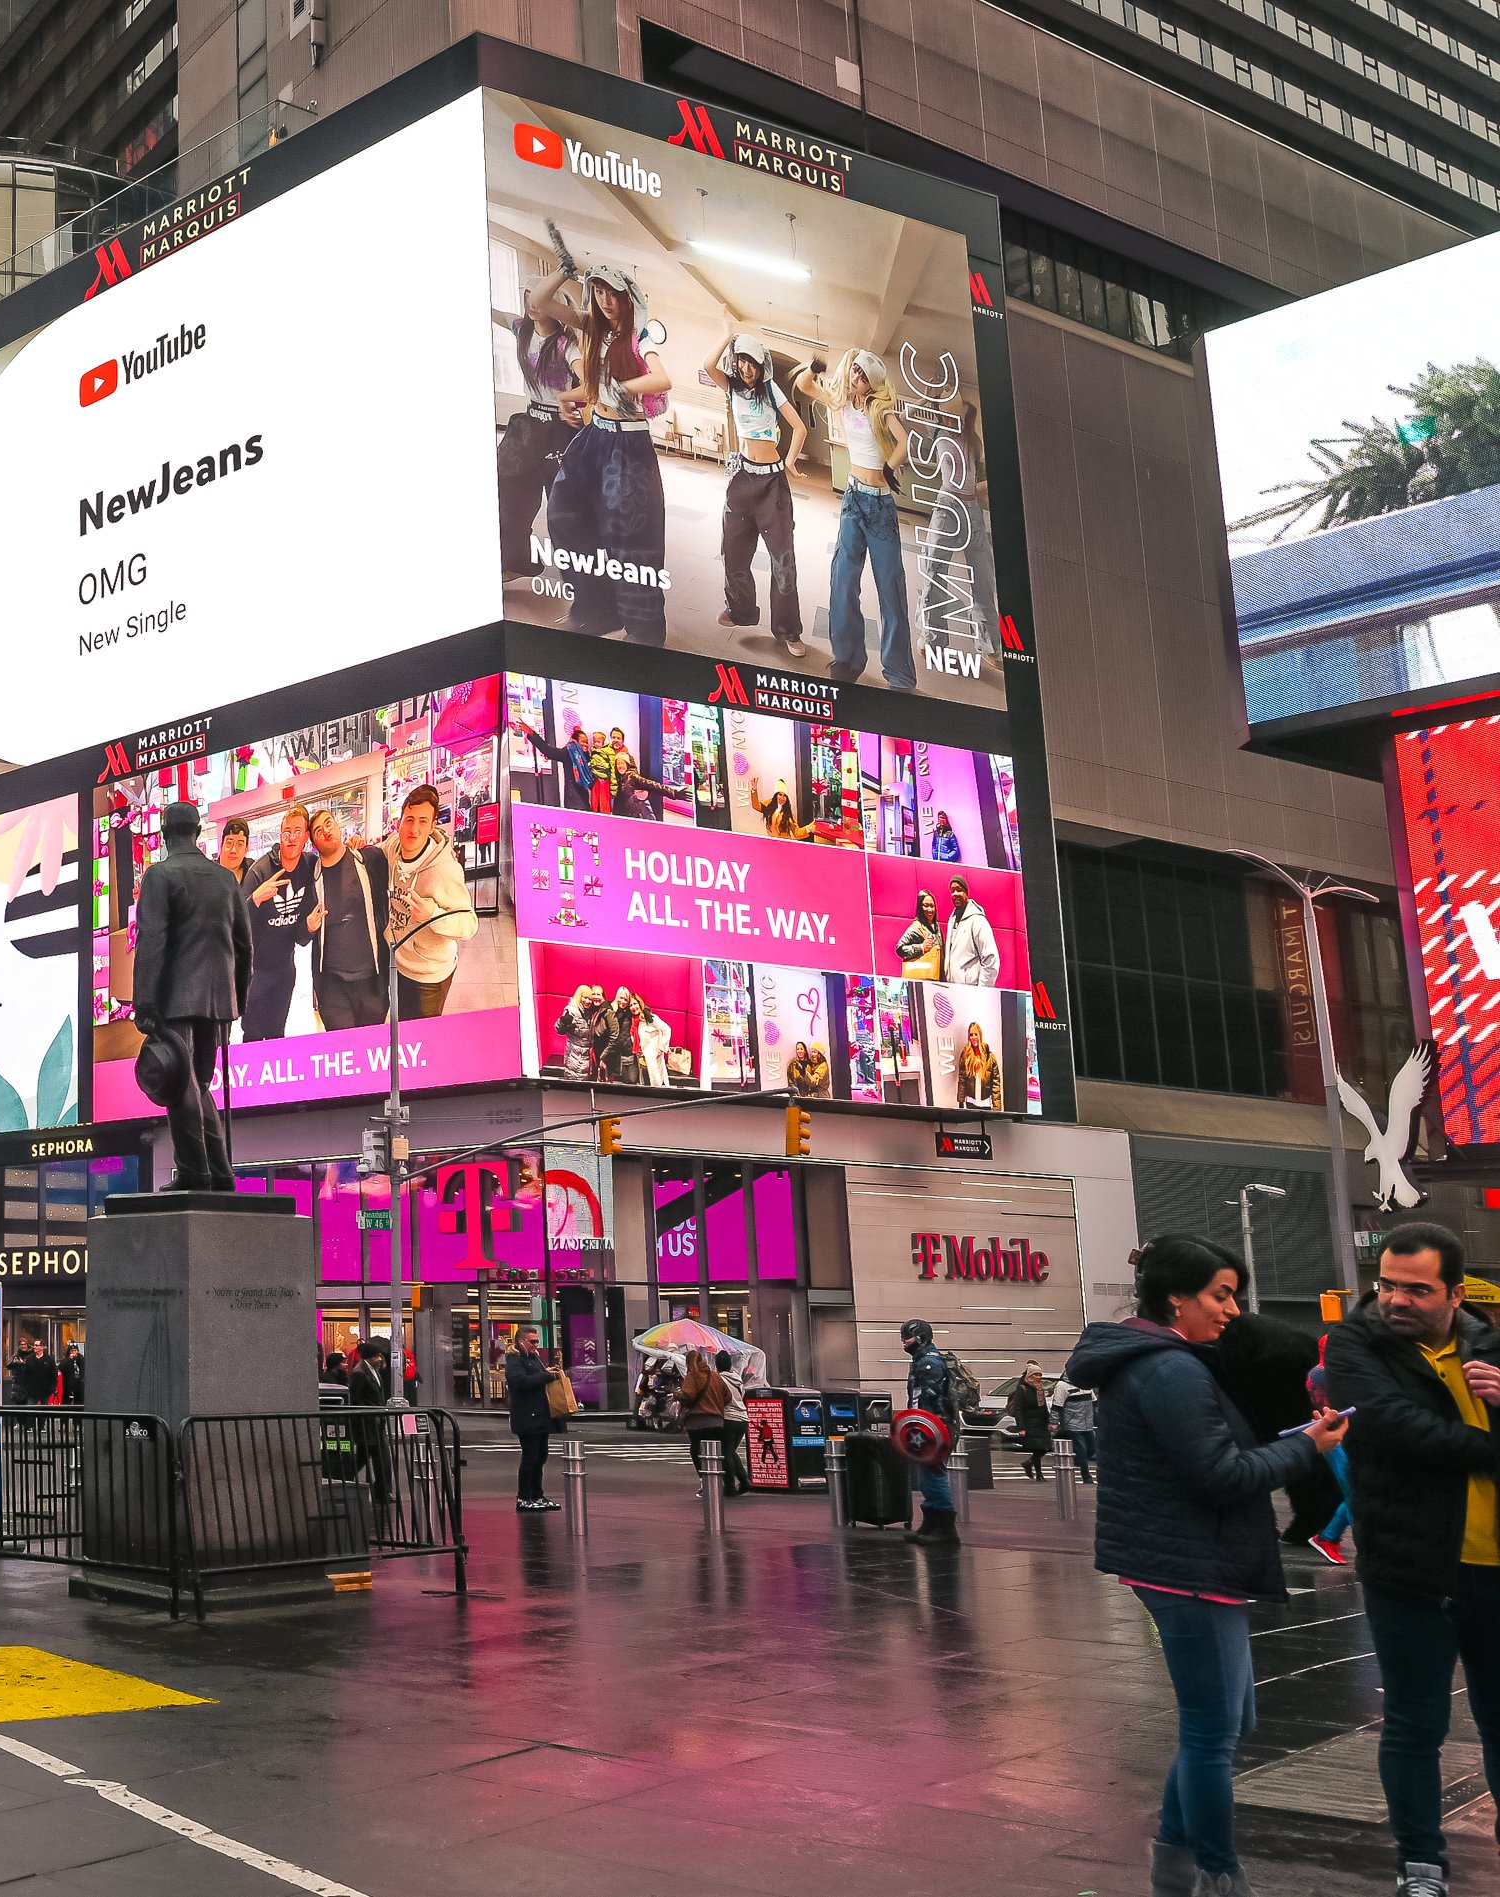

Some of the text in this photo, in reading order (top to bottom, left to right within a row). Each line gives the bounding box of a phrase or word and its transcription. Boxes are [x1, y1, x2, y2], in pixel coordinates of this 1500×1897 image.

[565, 137, 662, 198] YouTube
[736, 120, 853, 172] MARRIOTT
[738, 145, 841, 192] MARQUIS
[143, 167, 251, 240] MARRIOTT
[142, 199, 237, 263] MARQUIS
[973, 305, 1003, 320] ARRIOTT
[122, 323, 206, 384] YouTube
[80, 434, 264, 537] NewJeans
[900, 341, 980, 640] MUSIC
[79, 553, 147, 605] OMG
[529, 534, 672, 590] NewJeans
[531, 576, 575, 600] OMG
[80, 601, 186, 656] New Single
[924, 644, 982, 680] NEW
[1003, 651, 1035, 664] ARRIOTT
[756, 673, 839, 700] MARRIOTT
[758, 692, 831, 717] MARQUIS
[137, 717, 213, 750] MARRIOTT
[137, 737, 204, 767] MARQUIS
[625, 848, 751, 894] HOLIDAY
[627, 891, 837, 944] ALL. THE. WAY.
[760, 974, 778, 1018] NYC
[1035, 1022, 1067, 1031] ARRIOTT
[259, 1058, 304, 1085] ALL.
[310, 1051, 361, 1079] THE.
[366, 1042, 427, 1072] WAY.
[31, 1139, 94, 1157] SEPHORA
